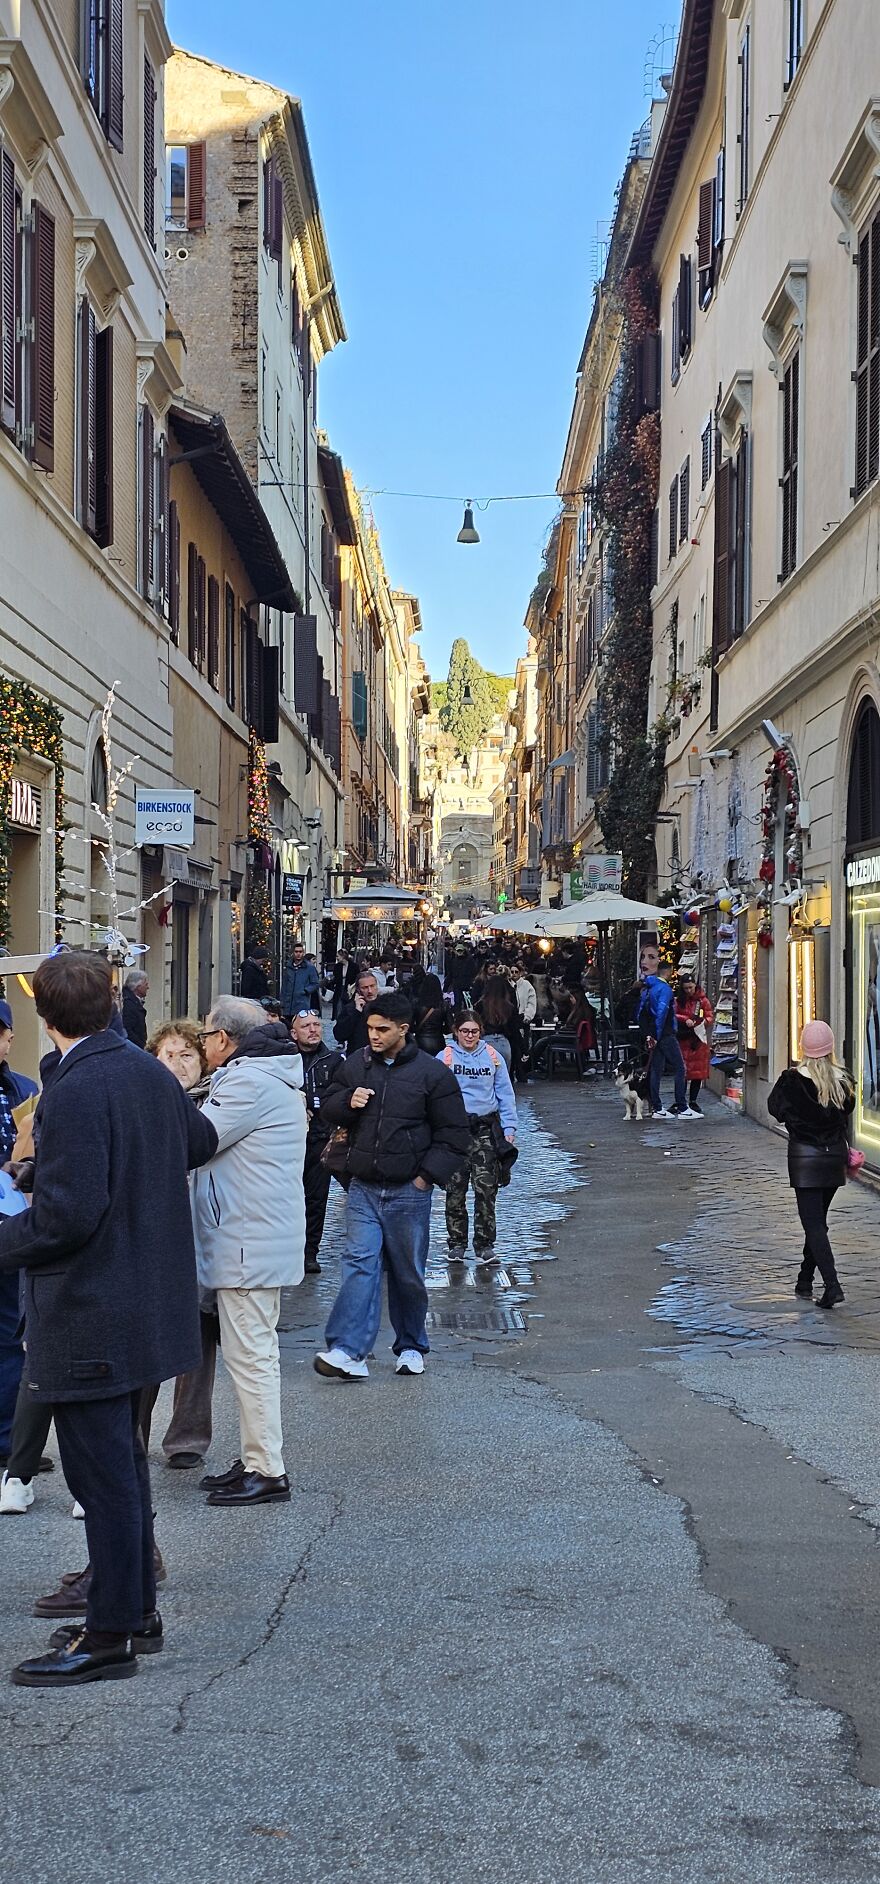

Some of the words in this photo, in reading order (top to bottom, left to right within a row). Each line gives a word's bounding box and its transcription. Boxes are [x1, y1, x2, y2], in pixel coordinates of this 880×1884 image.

[137, 802, 192, 813] BIRKENSTOCK
[146, 821, 183, 831] ecco
[599, 883, 620, 891] WORLD
